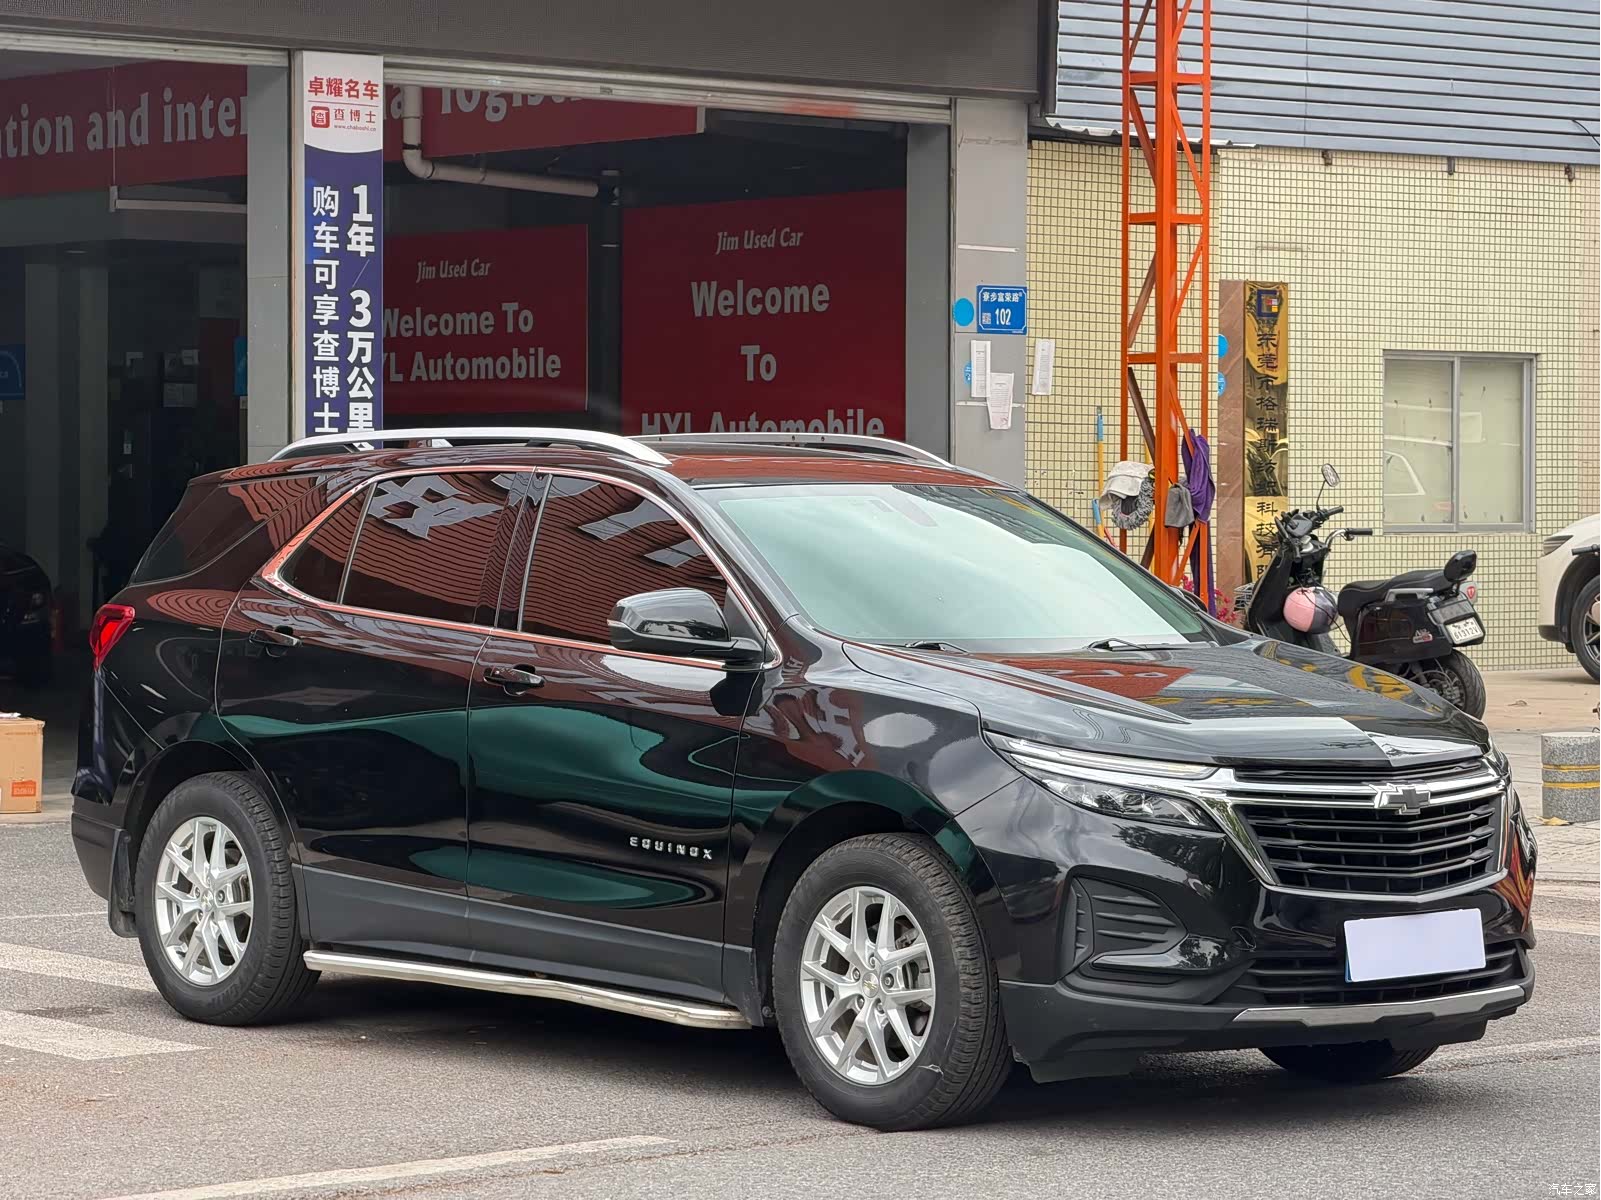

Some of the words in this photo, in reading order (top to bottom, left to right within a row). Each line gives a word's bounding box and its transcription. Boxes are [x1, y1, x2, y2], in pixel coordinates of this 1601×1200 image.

[308, 76, 379, 100] 卓耀名车
[0, 103, 74, 159] tion
[86, 91, 149, 151] and
[334, 108, 376, 123] 查博士
[715, 232, 739, 255] Jim
[743, 229, 776, 250] Used
[780, 227, 804, 248] Car
[415, 261, 436, 283] Jim
[439, 259, 468, 279] Used
[471, 257, 491, 276] Car
[313, 185, 340, 433] 购车可享查博士
[691, 279, 830, 318] Welcome
[502, 302, 534, 333] To
[995, 308, 1011, 326] 102
[410, 347, 562, 382] Automobile
[740, 344, 777, 381] To
[629, 836, 713, 860] EQUINOX
